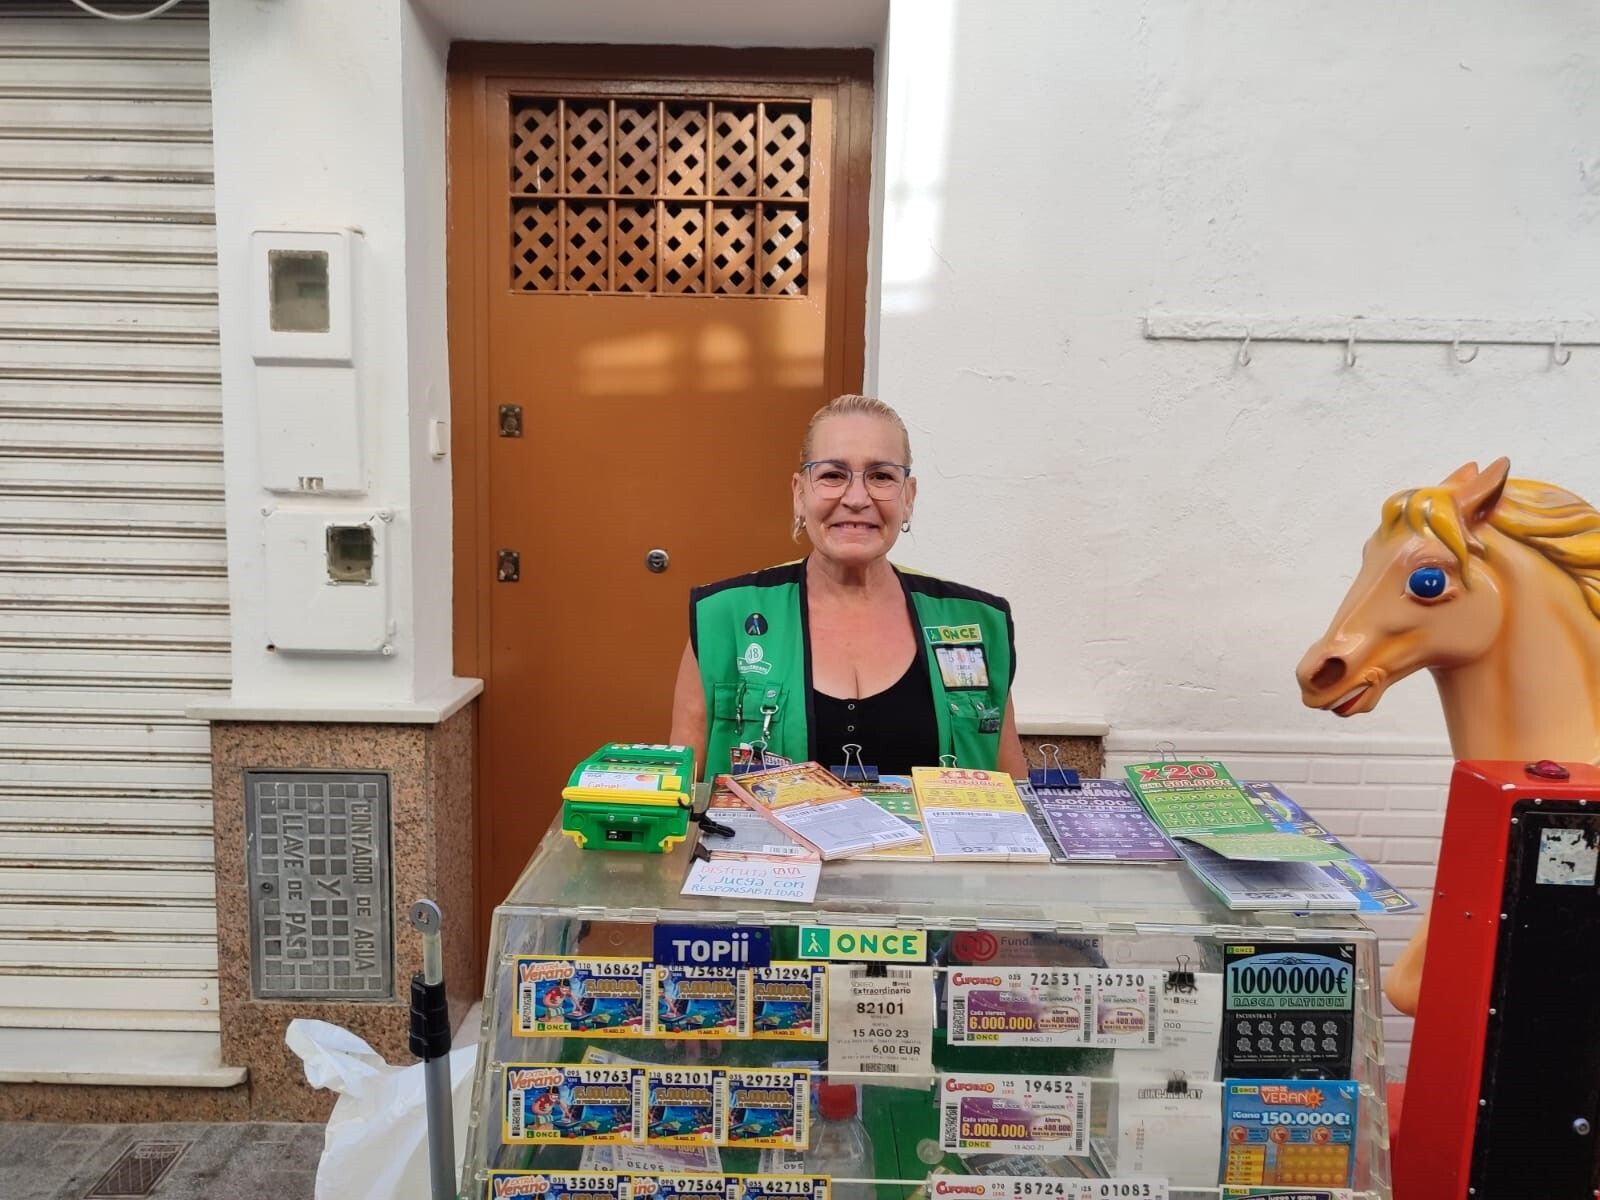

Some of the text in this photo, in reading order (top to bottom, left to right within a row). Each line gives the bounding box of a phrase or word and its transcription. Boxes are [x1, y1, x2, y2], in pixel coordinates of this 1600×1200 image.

[943, 628, 977, 639] ONCE
[1037, 787, 1131, 798] MILLONARIO
[283, 815, 307, 959] LLAVE DE PASO
[350, 803, 375, 971] CONTADOR DE AGUA
[691, 884, 804, 897] RESPONSABILIDAD
[837, 934, 918, 954] ONCE
[521, 964, 574, 981] Verano
[597, 963, 639, 976] 16862
[764, 967, 809, 979] 91294
[1031, 973, 1079, 986] 72531
[853, 987, 911, 995] Extraordinario
[857, 1002, 904, 1015] 82101
[1234, 997, 1344, 1007] RASCA PLATINUM
[853, 1029, 909, 1038] 15 AGO 23
[873, 1045, 920, 1055] 6,00 EUR
[510, 1070, 562, 1089] Verano
[586, 1070, 628, 1083] 19763
[665, 1072, 709, 1084] 82101
[746, 1075, 791, 1087] 29752
[1025, 1080, 1072, 1093] 19452
[1261, 1111, 1350, 1125] 150.000€!
[495, 1178, 549, 1197] Verano
[570, 1177, 614, 1189] 35058
[678, 1180, 723, 1191] 97564
[766, 1182, 810, 1193] 42718
[1014, 1182, 1064, 1195] 58724
[1100, 1184, 1150, 1197] 01083
